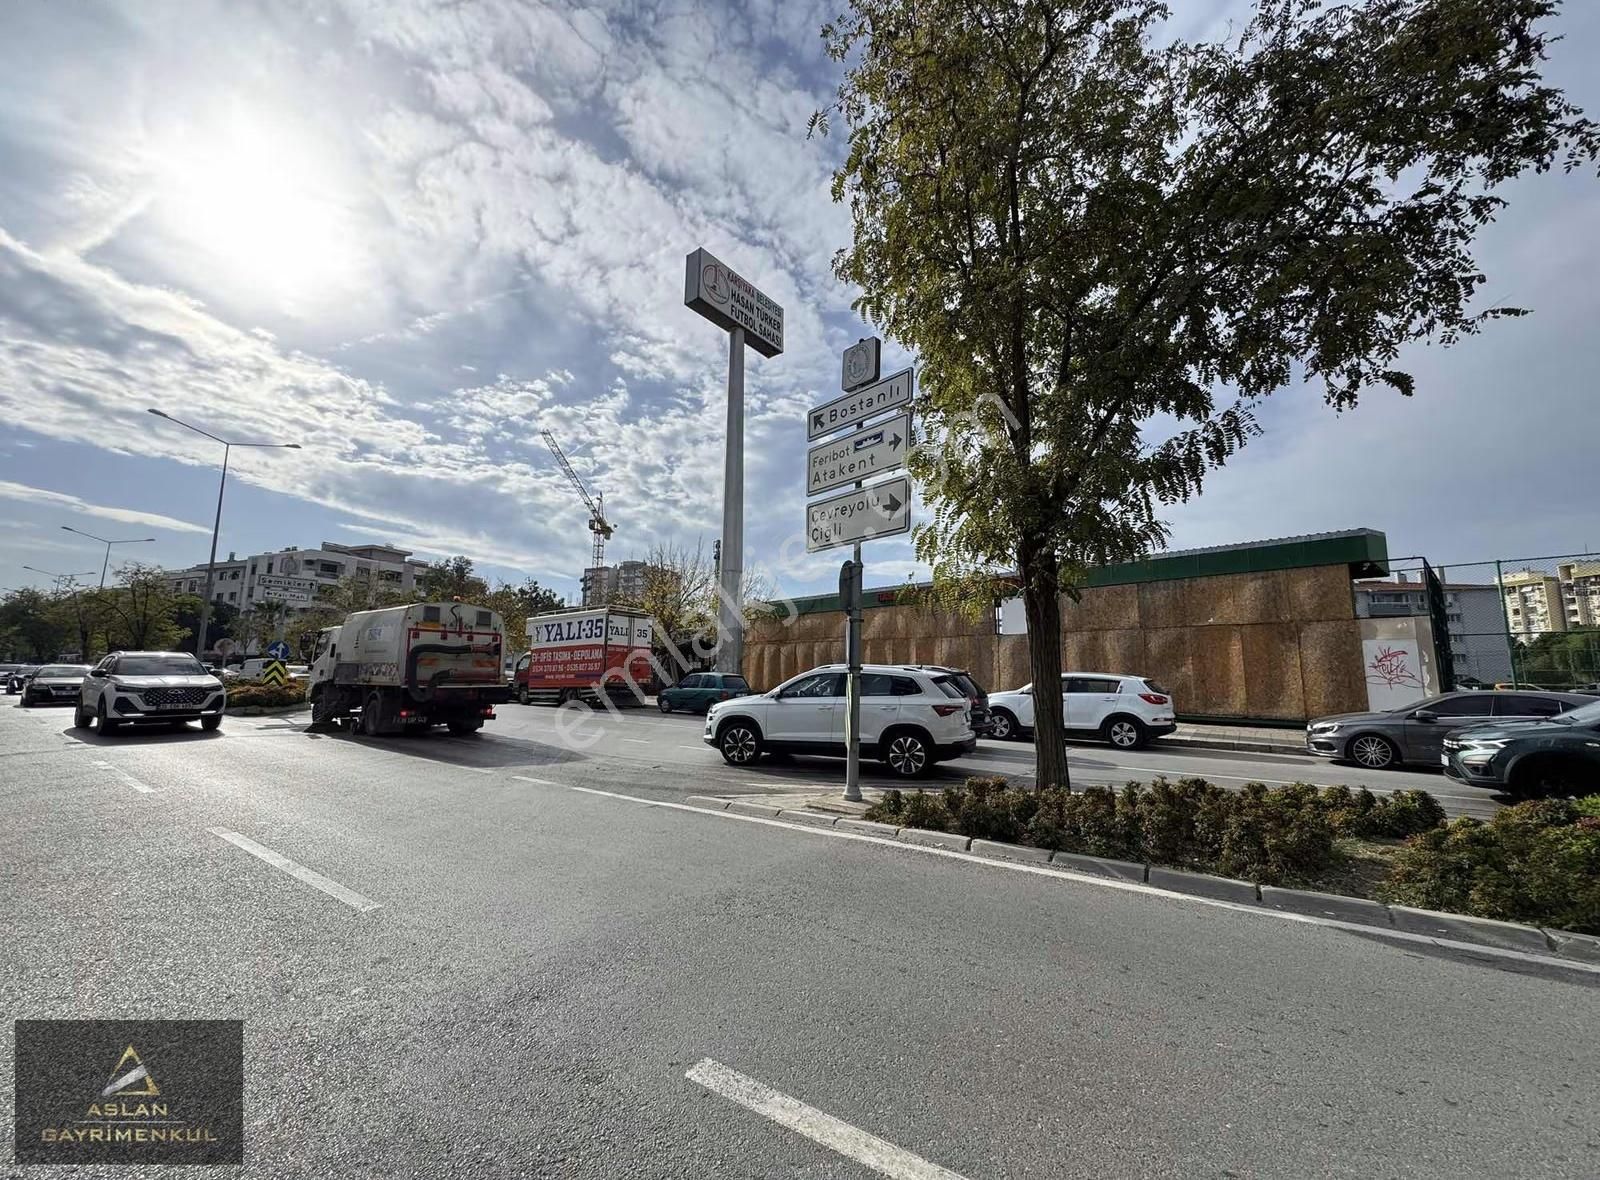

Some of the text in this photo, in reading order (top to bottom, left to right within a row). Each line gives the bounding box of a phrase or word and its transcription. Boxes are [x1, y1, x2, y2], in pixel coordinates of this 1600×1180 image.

[731, 288, 755, 315] HASAN
[730, 304, 782, 348] FUTBOL SAHASI
[829, 384, 900, 422] Bostanlı
[812, 446, 850, 468] Feribot
[812, 453, 875, 486] Atakent
[812, 496, 880, 525] Çevreyolu
[811, 523, 842, 543] Çiğli
[610, 625, 648, 638] YALI 35
